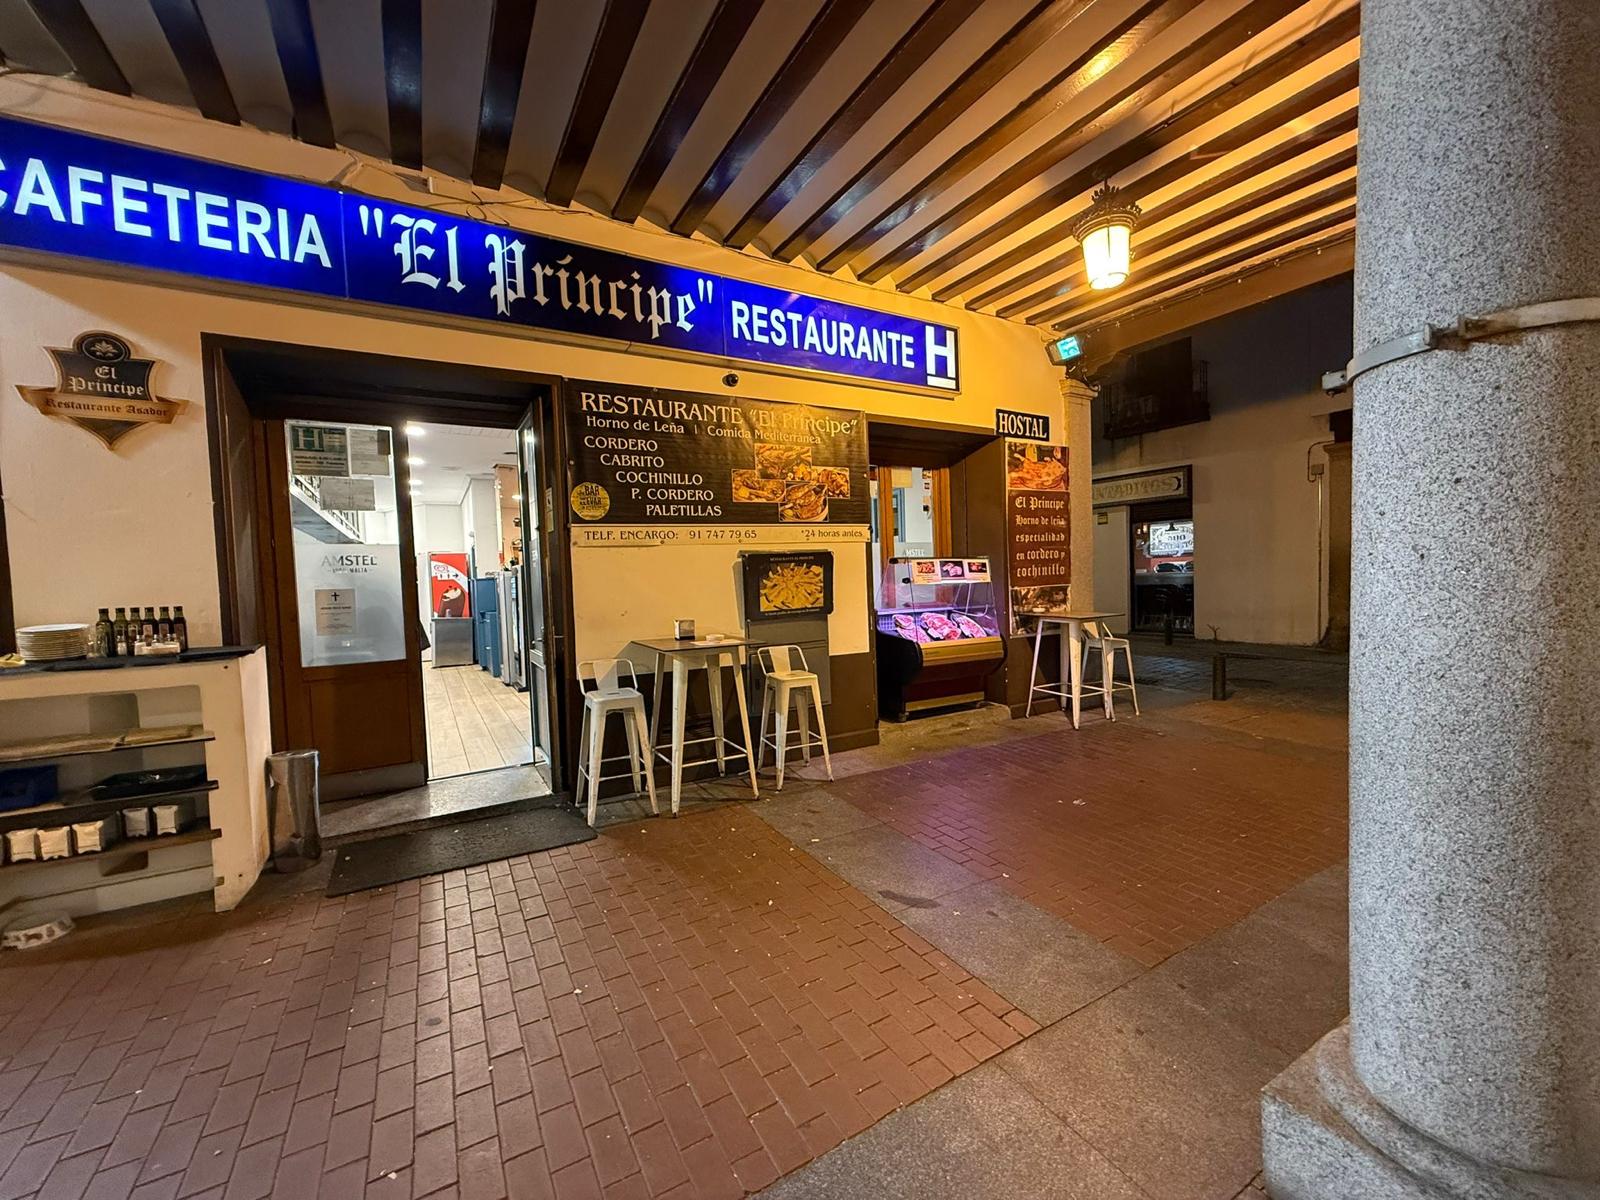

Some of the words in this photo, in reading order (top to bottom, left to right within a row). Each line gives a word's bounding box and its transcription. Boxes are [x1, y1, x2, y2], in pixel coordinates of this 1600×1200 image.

[731, 300, 916, 369] RESTAURANTE
[94, 365, 117, 379] El
[46, 399, 122, 413] Restaurante
[125, 405, 169, 417] Asador
[580, 391, 743, 424] RESTAURANTE
[586, 415, 630, 430] Horno
[633, 419, 650, 431] de
[654, 421, 685, 434] Leña
[707, 425, 751, 438] Comida
[998, 412, 1048, 438] HOSTAL
[584, 435, 658, 452] CORDERO
[600, 453, 665, 468] CABRITO
[615, 471, 703, 486] COCHINILLO
[631, 488, 642, 500] P.
[647, 488, 714, 501] CORDERO
[646, 504, 722, 517] PALETILLAS
[1015, 496, 1027, 508] El
[1029, 496, 1065, 511] Príncipe
[1015, 514, 1040, 526] Horno
[1040, 515, 1049, 525] de
[584, 530, 616, 541] TELF.
[620, 530, 679, 541] ENCARGO:
[689, 530, 701, 540] 91
[706, 530, 725, 540] 747
[729, 530, 741, 540] 79
[744, 530, 757, 539] 65
[818, 529, 841, 538] horas
[1015, 532, 1066, 543] especialidad
[321, 554, 377, 567] AMSTEL
[1016, 551, 1026, 561] en
[1026, 547, 1060, 560] cordero
[1016, 563, 1066, 577] cochinillo
